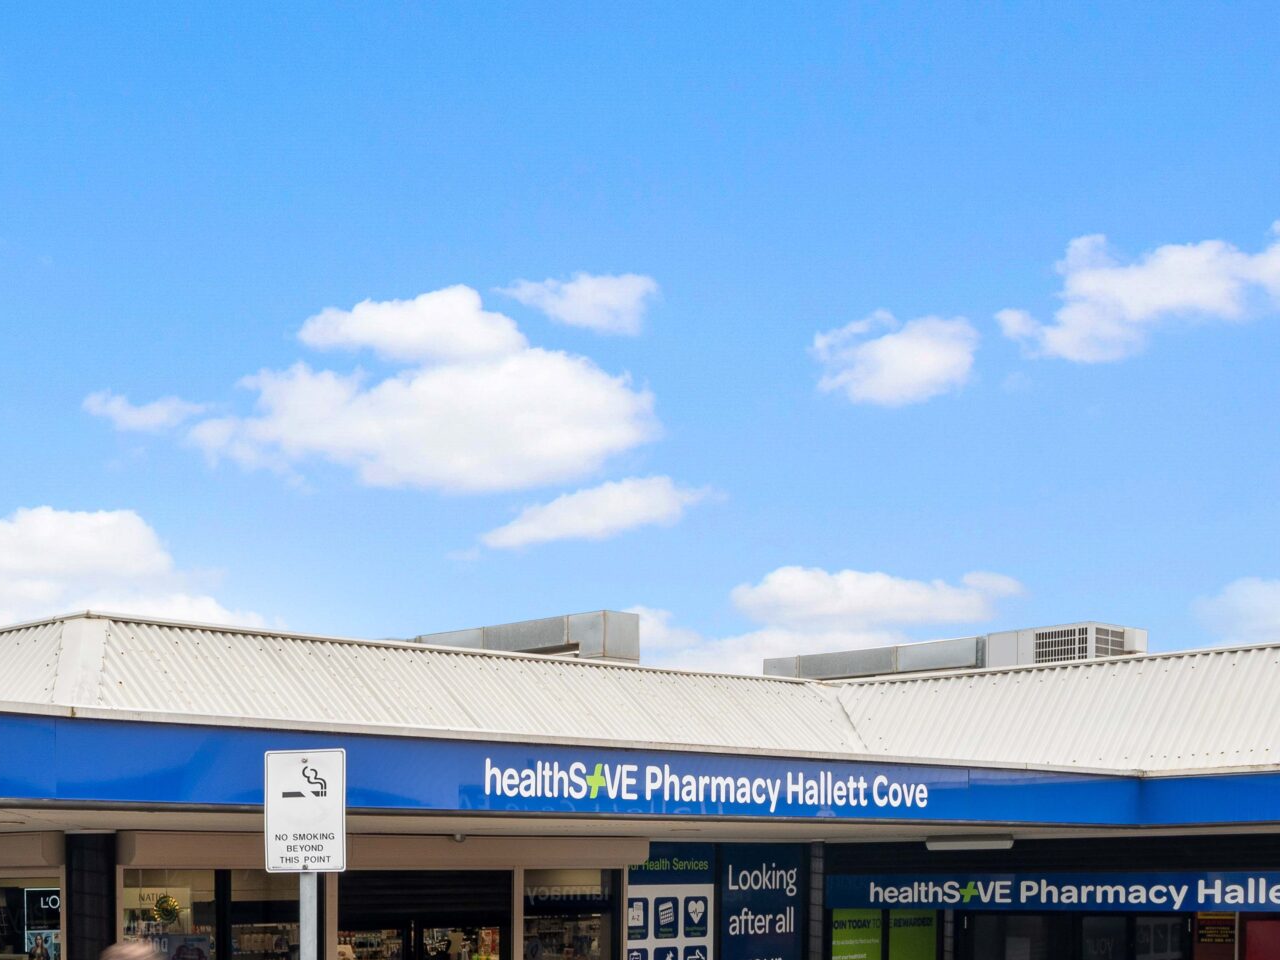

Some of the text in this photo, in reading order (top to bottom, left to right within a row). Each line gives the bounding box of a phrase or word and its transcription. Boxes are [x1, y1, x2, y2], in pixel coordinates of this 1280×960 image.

[645, 763, 782, 813] Pharmacy
[786, 771, 868, 807] Hallett
[872, 775, 928, 808] Cove
[286, 844, 323, 852] BEYOND
[292, 833, 335, 841] SMOKING
[672, 857, 708, 871] Services
[728, 863, 797, 896] Looking
[1020, 880, 1188, 910] Pharmacy
[729, 906, 794, 935] after all
